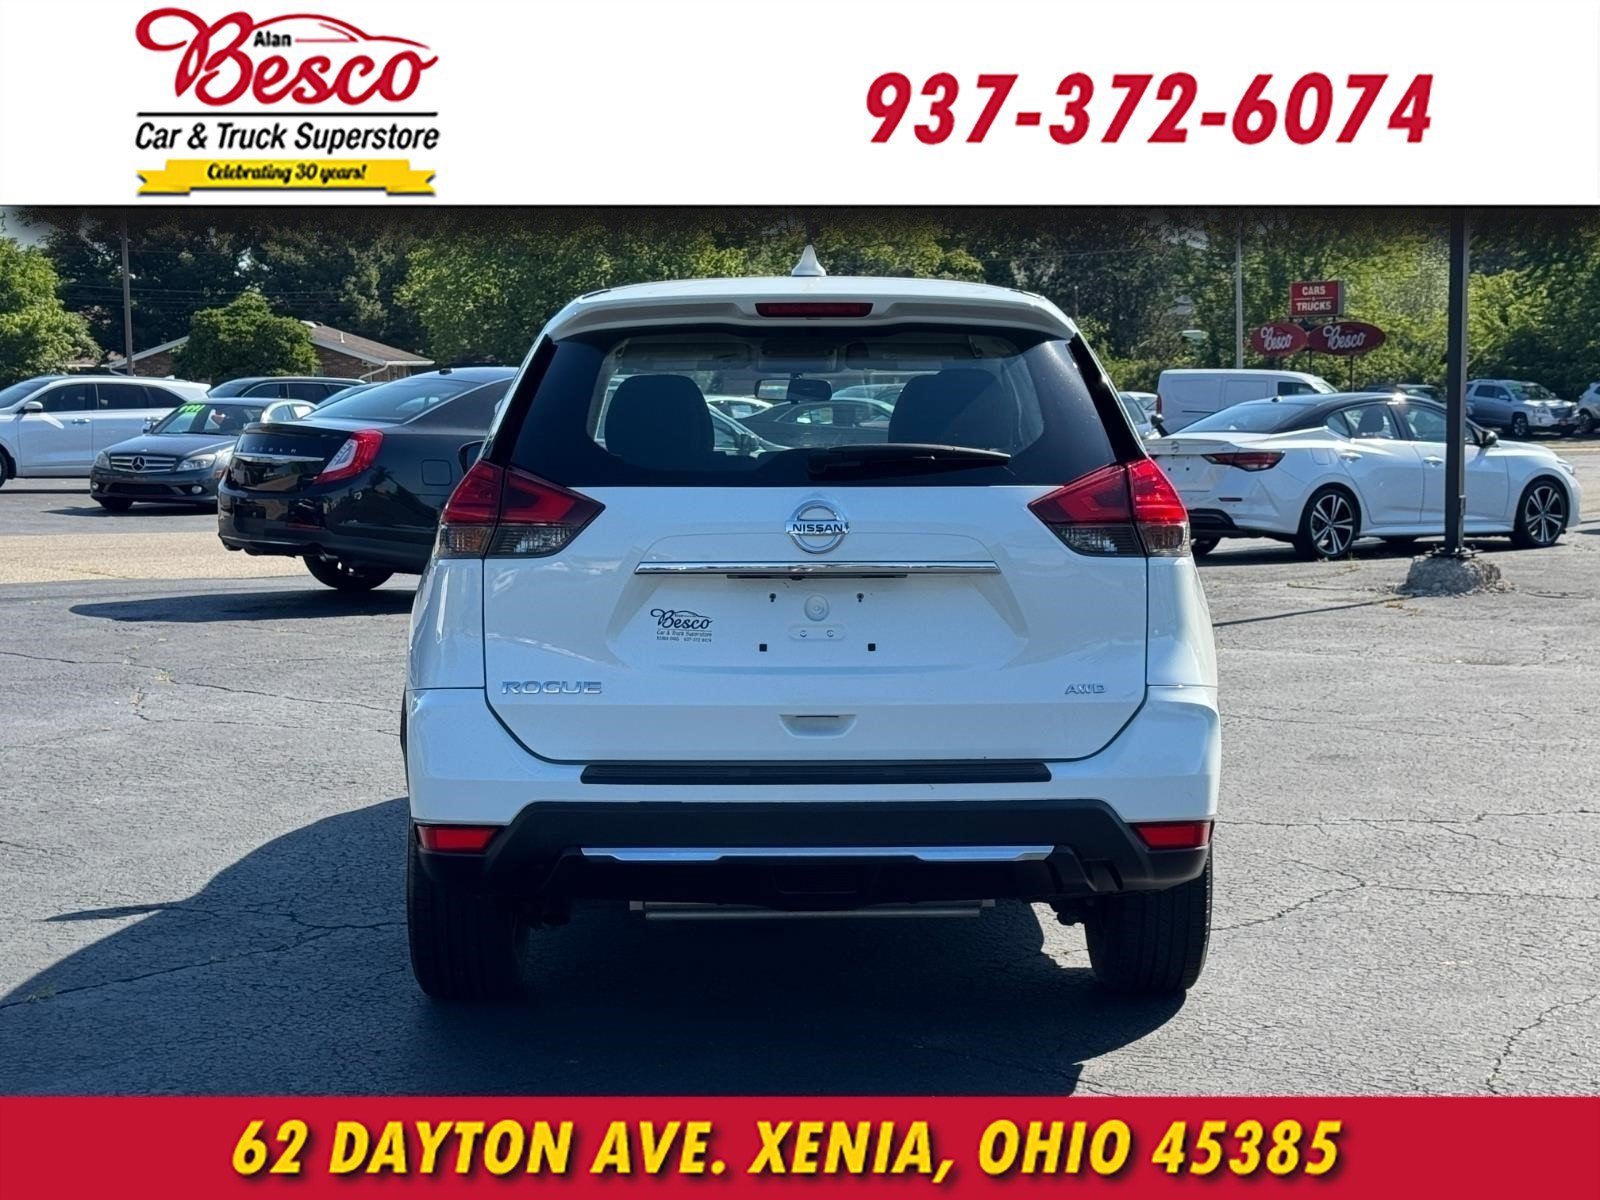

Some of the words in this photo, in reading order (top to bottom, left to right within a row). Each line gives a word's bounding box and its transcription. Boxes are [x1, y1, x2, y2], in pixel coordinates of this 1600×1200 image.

[1302, 286, 1326, 296] CARS
[1295, 302, 1332, 311] TRUCKS
[1322, 325, 1366, 349] Besco
[793, 523, 843, 532] NISSAN
[650, 608, 713, 629] Besco
[501, 680, 602, 694] ROGUE
